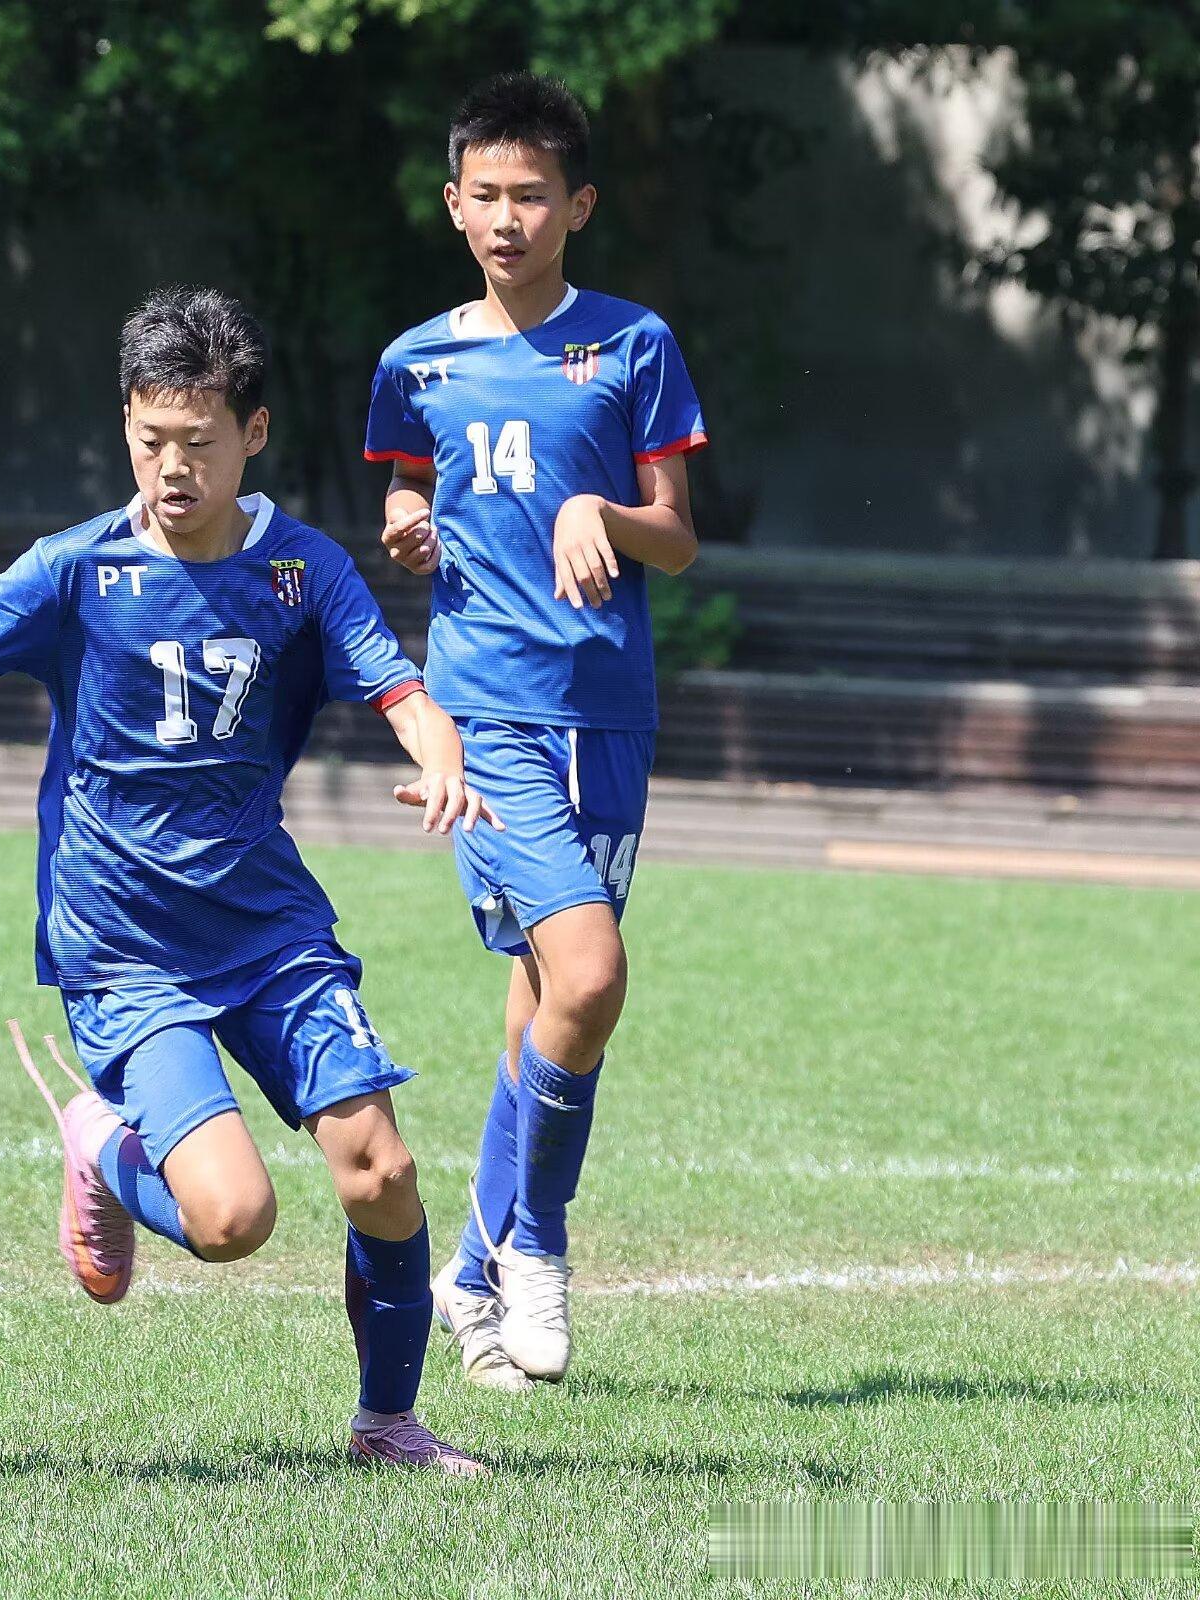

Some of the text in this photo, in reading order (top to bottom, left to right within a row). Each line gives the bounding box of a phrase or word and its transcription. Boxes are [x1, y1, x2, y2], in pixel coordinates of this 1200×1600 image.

[409, 356, 456, 390] PT
[466, 420, 536, 495] 14
[97, 565, 149, 597] PT
[150, 638, 261, 745] 17
[590, 833, 637, 899] 14
